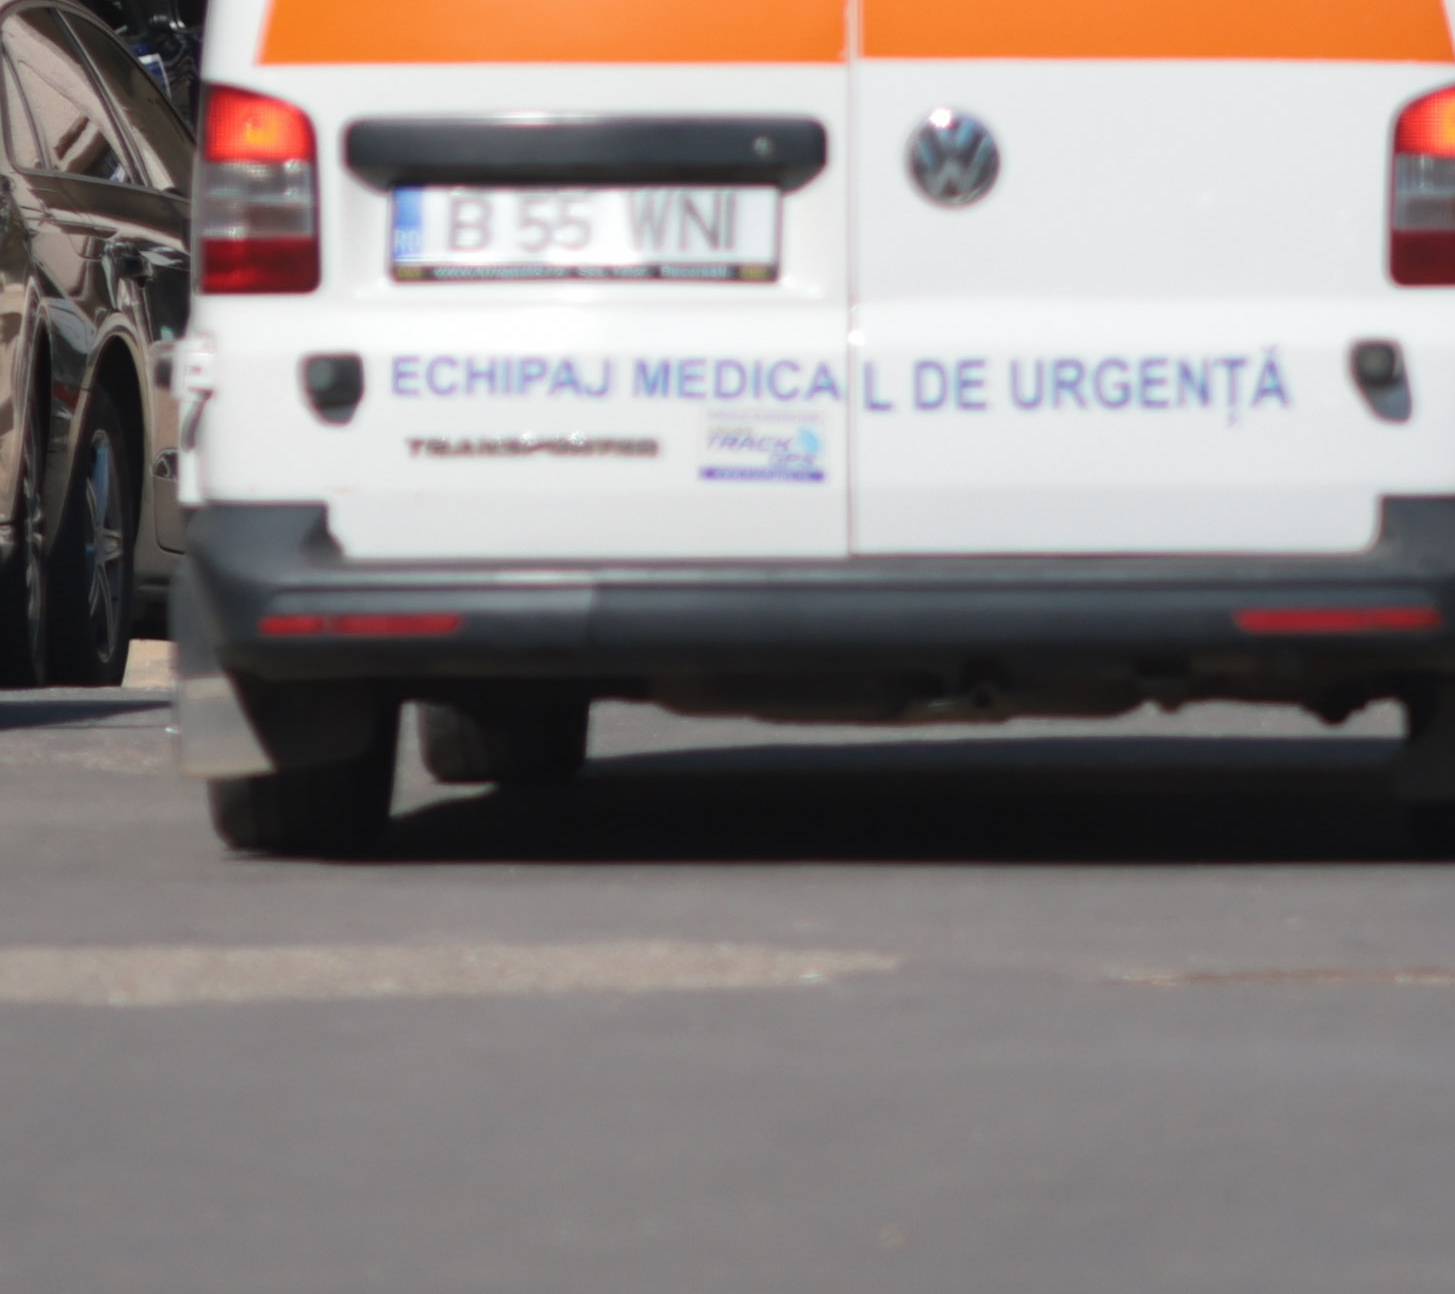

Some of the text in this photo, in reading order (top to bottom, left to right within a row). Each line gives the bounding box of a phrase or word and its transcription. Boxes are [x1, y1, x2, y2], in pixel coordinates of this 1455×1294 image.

[448, 191, 738, 253] B 55 WNI
[390, 344, 1293, 428] ECHIPAJ MEDICAL DE URGENȚĂ
